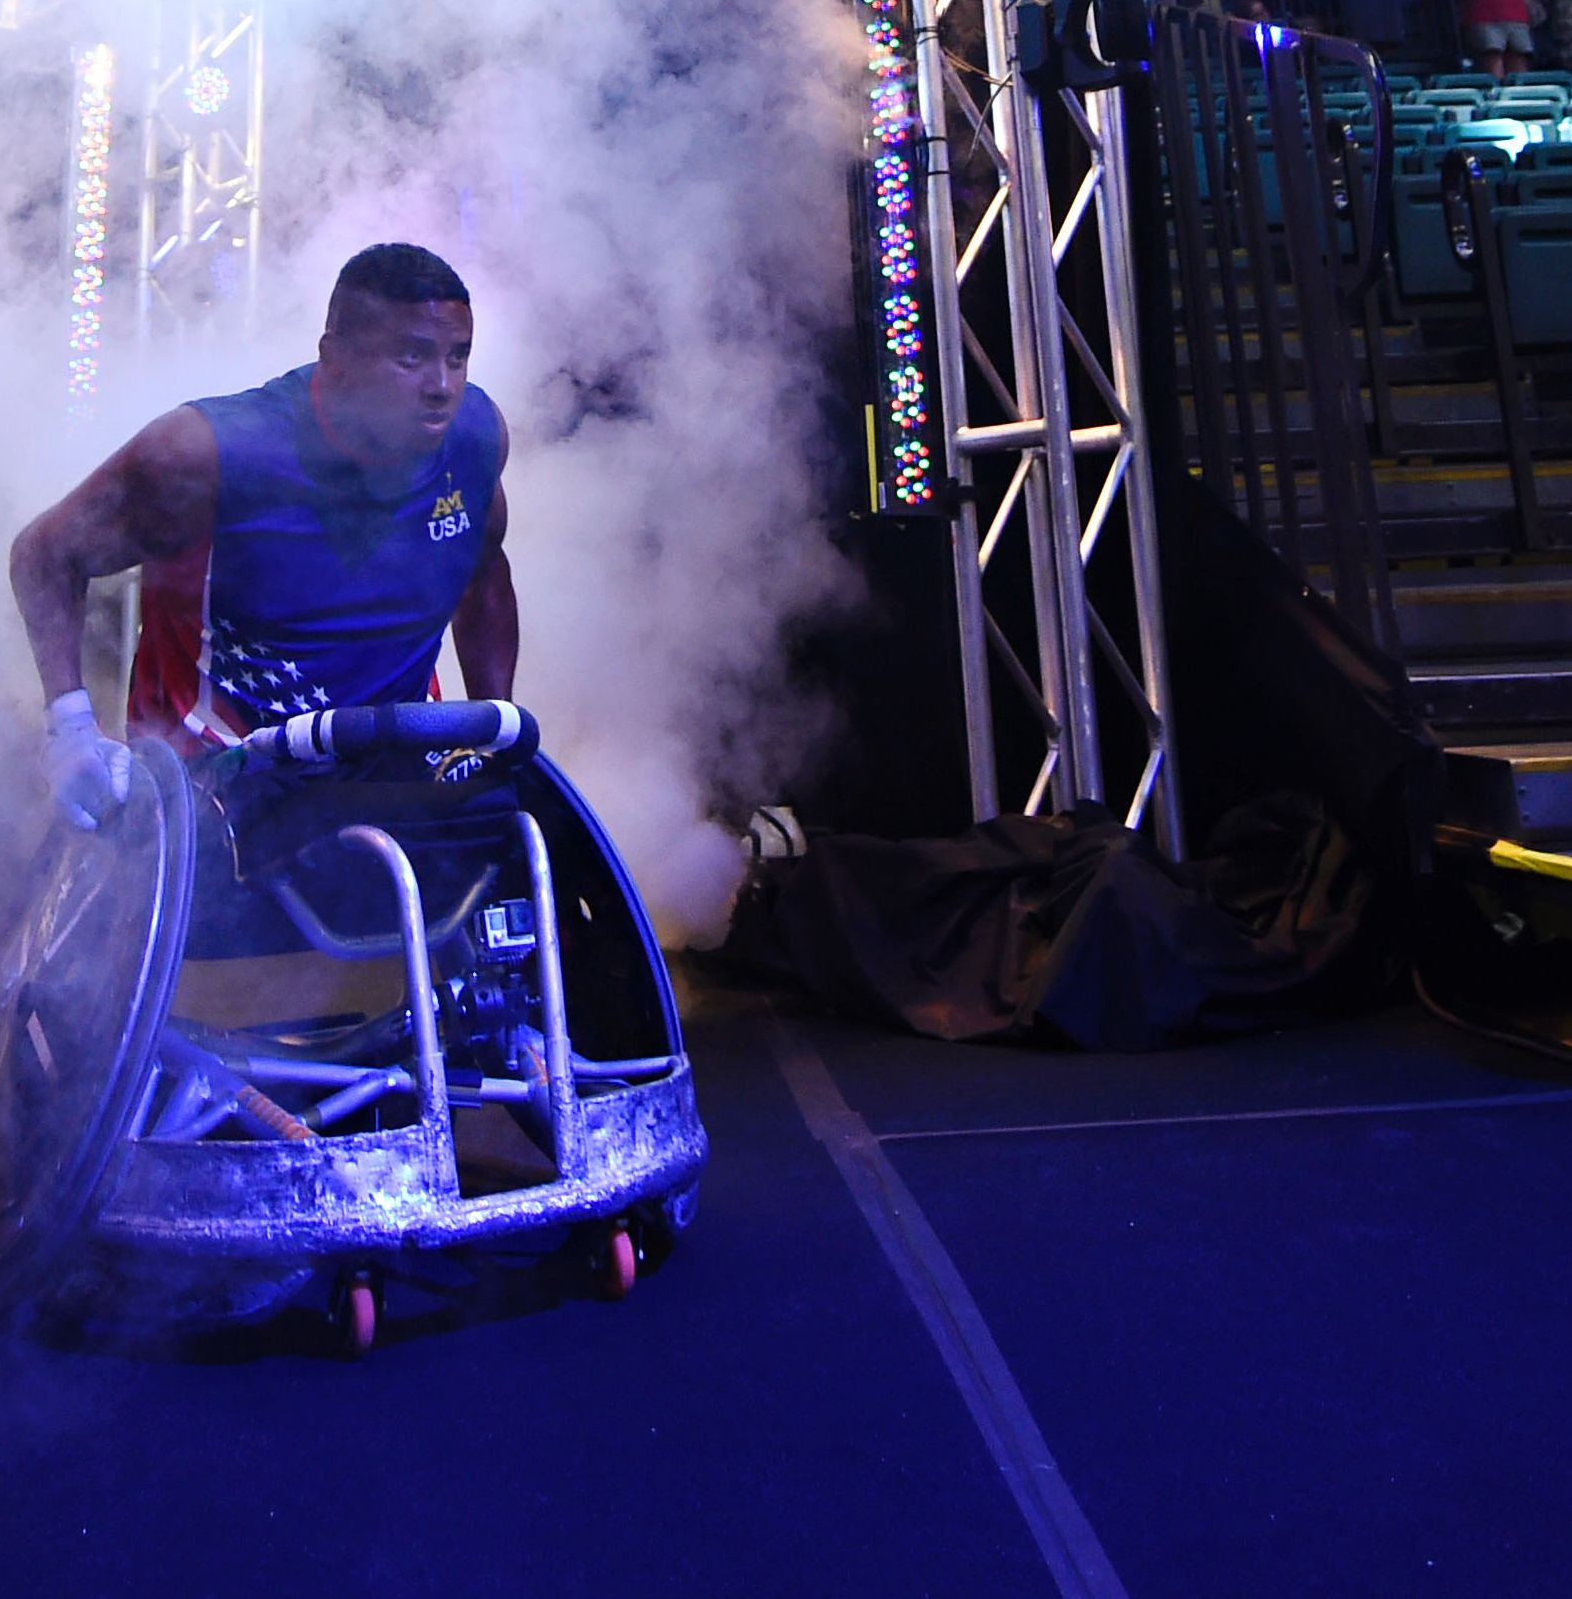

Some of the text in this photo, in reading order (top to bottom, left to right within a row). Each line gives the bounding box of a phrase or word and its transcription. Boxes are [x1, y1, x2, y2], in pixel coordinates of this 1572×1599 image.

[431, 490, 464, 518] AM
[427, 513, 471, 541] USA
[441, 756, 483, 781] 775
